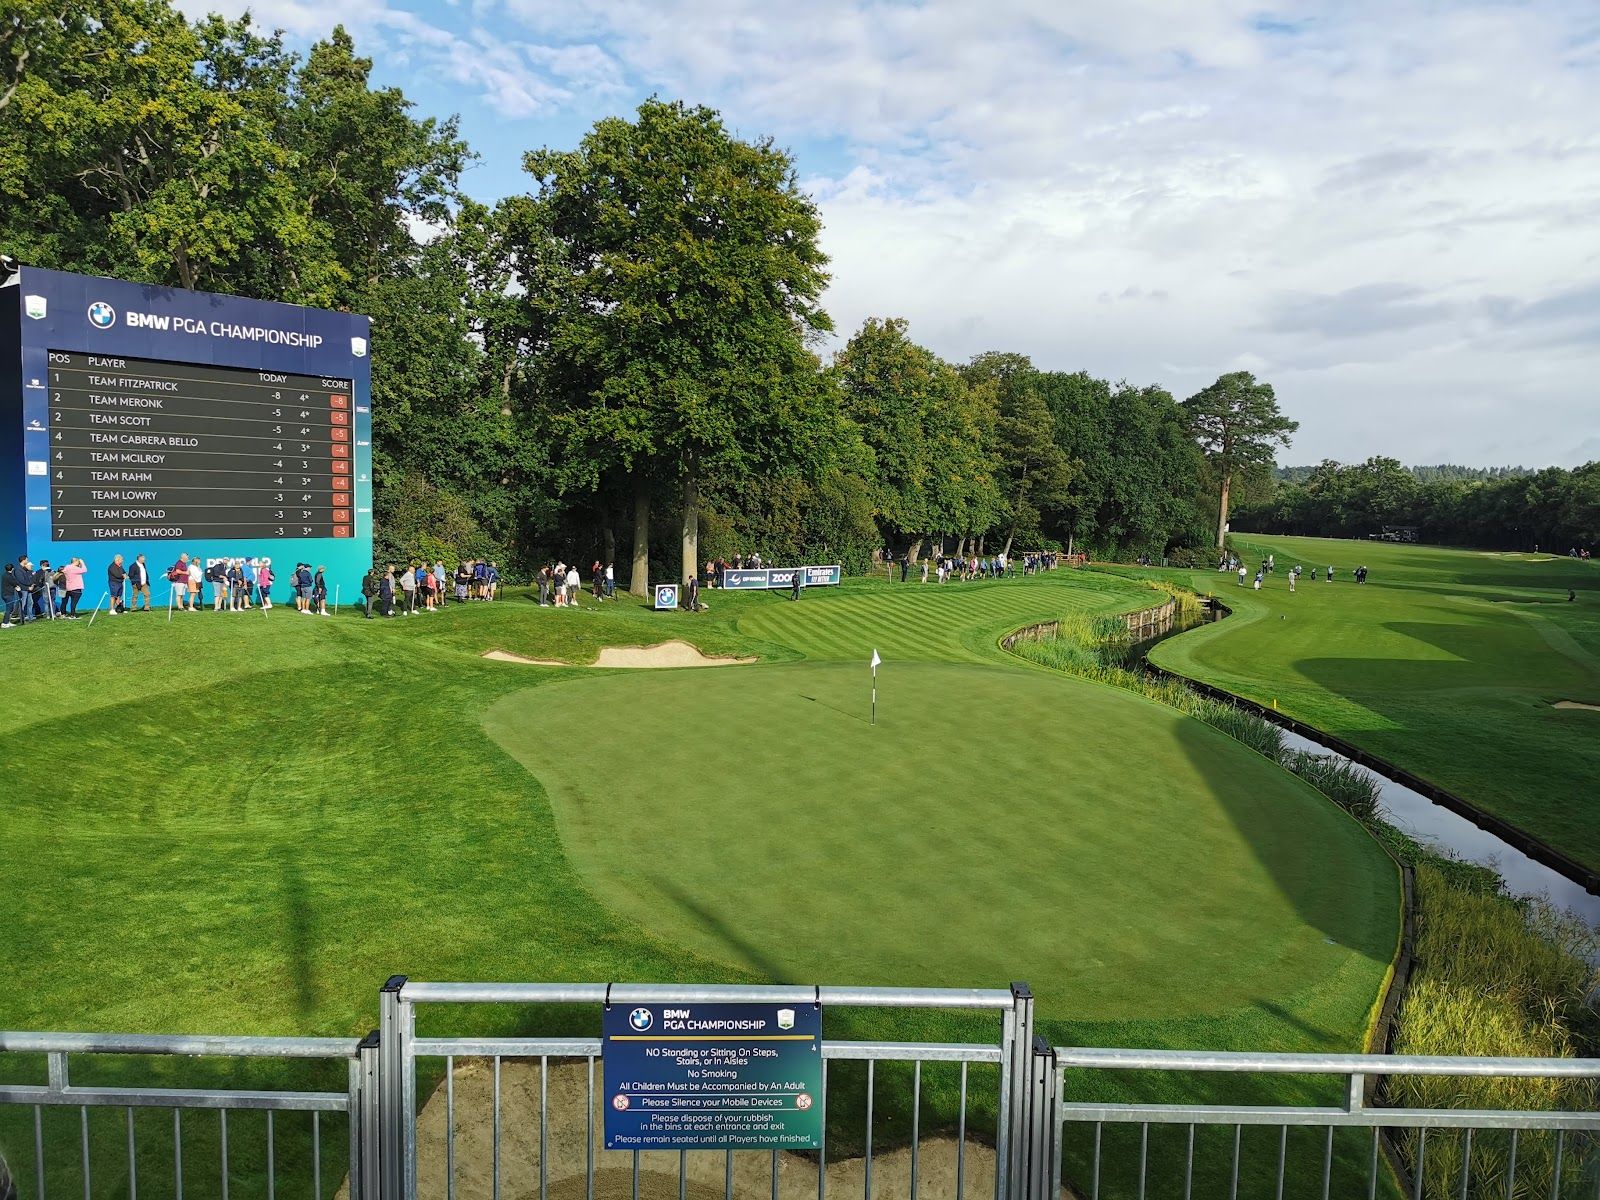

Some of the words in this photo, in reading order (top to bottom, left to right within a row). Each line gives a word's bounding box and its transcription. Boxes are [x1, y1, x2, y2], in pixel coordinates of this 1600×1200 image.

[126, 311, 170, 330] BMW
[173, 317, 207, 335] PGA
[210, 322, 322, 348] CHAMPIONSHIP
[49, 353, 70, 364] POS
[88, 356, 126, 369] PLAYER
[258, 372, 288, 384] TODAY
[322, 380, 349, 390] SCORE
[54, 373, 60, 382] 1
[88, 376, 116, 387] TEAM
[119, 378, 178, 392] FITZPATRICK
[272, 392, 281, 400] -8
[54, 392, 61, 402] 2
[89, 395, 117, 406] TEAM
[120, 397, 163, 409] MERONK
[272, 408, 281, 417] -5
[55, 412, 61, 422] 2
[90, 414, 117, 425] TEAM
[120, 416, 151, 427] SCOTT
[272, 426, 282, 434] -5
[55, 432, 62, 441] 4
[90, 433, 118, 444] TEAM
[120, 434, 166, 446] CABRERA
[169, 437, 198, 447] BELLO
[273, 443, 282, 451] -4
[56, 452, 63, 460] 4
[90, 452, 118, 462] TEAM
[121, 454, 165, 464] MCILROY
[273, 460, 283, 468] -4
[302, 461, 308, 469] 3
[56, 471, 64, 480] 4
[91, 471, 119, 481] TEAM
[122, 472, 152, 482] RAHM
[274, 477, 283, 485] -4
[57, 490, 64, 500] 7
[91, 491, 119, 500] TEAM
[122, 491, 157, 500] LOWRY
[274, 494, 283, 502] -3
[57, 510, 64, 519] 7
[92, 510, 120, 519] TEAM
[122, 510, 165, 519] DONALD
[274, 510, 284, 519] -3
[58, 529, 64, 538] 7
[92, 528, 120, 538] TEAM
[123, 528, 183, 537] FLEETWOOD
[663, 1010, 690, 1019] BMW
[664, 1021, 685, 1030] PGA
[687, 1020, 766, 1030] CHAMPIONSHIP
[646, 1048, 660, 1057] NO
[662, 1048, 698, 1058] Standing
[710, 1048, 736, 1058] Sitting
[738, 1048, 750, 1056] On
[753, 1048, 778, 1057] Steps,
[676, 1057, 702, 1066] Stairs,
[724, 1057, 748, 1065] Aisles
[702, 1070, 737, 1079] Smoking
[632, 1082, 665, 1090] Children
[702, 1082, 757, 1091] Accompanied
[759, 1082, 769, 1091] by
[642, 1098, 670, 1106] Please
[671, 1098, 700, 1106] Silence
[722, 1098, 749, 1106] Mobile
[751, 1098, 783, 1106] Devices
[681, 1114, 712, 1123] dispose
[729, 1135, 757, 1144] Players
